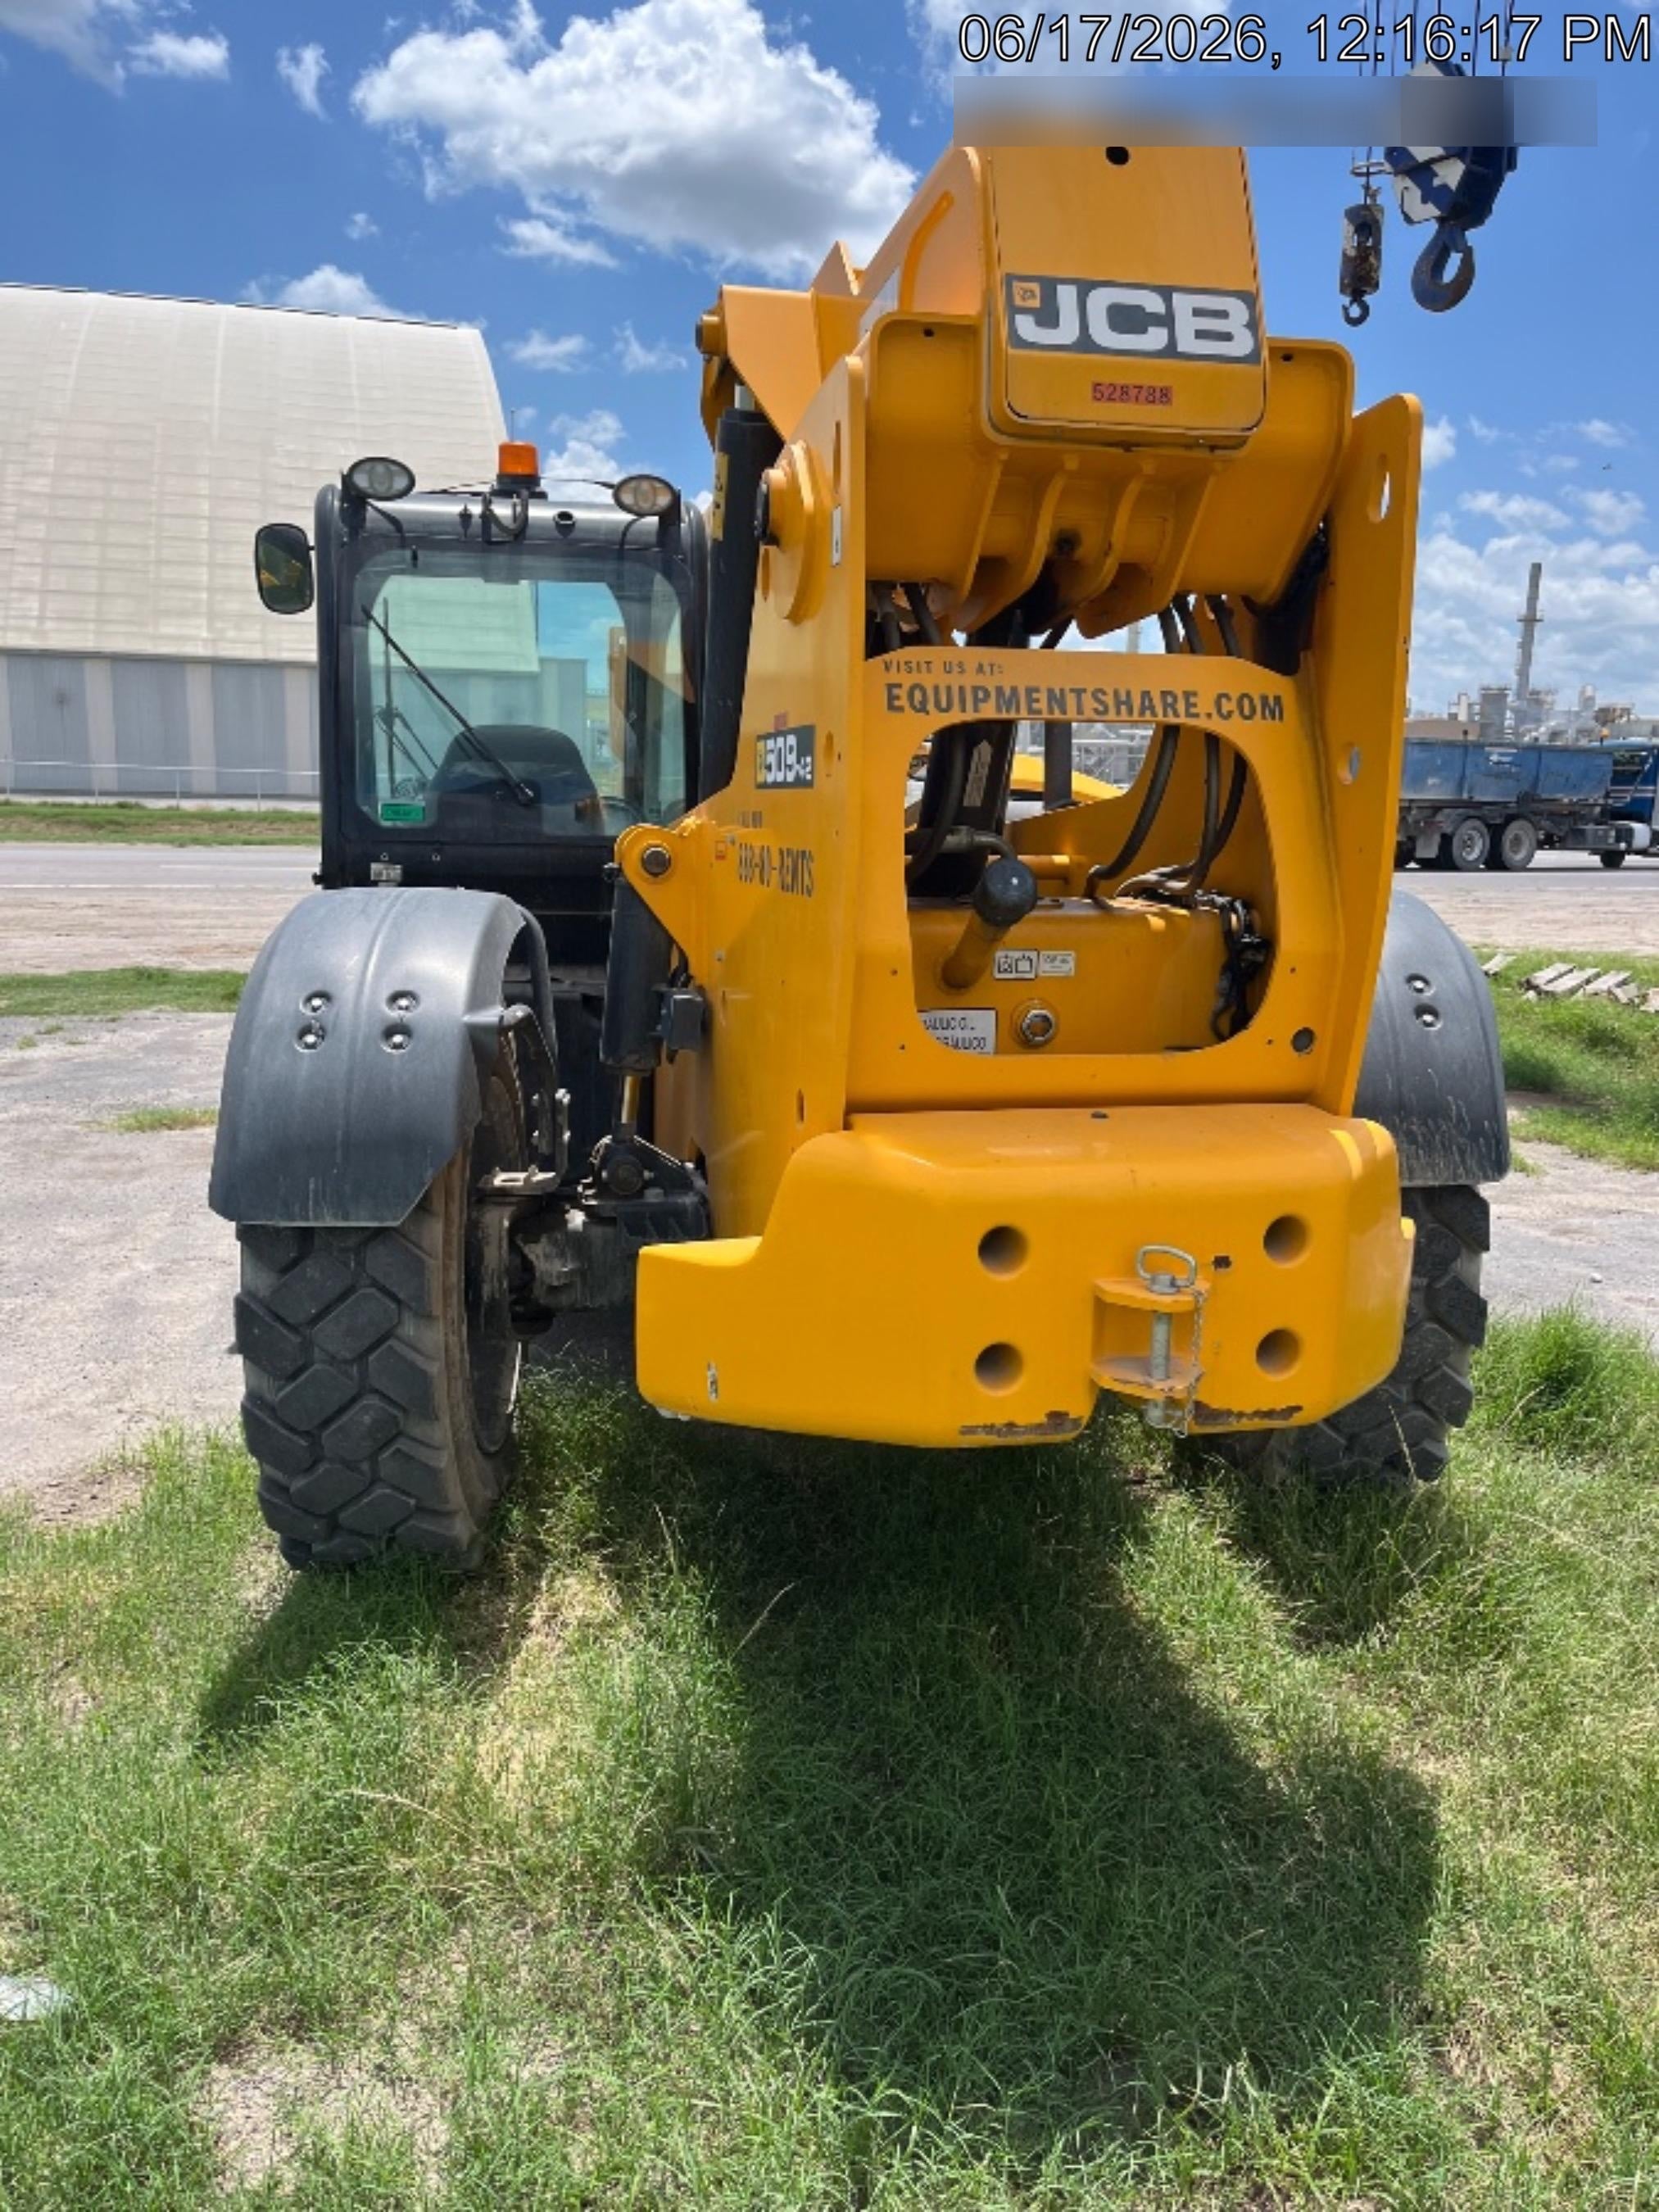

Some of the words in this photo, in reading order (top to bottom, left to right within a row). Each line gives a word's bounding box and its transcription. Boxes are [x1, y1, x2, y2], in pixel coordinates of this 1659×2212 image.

[1014, 283, 1254, 357] JCB
[883, 660, 933, 674] VISIT
[943, 660, 966, 674] US
[885, 682, 1285, 722] EQUIPMENTSHARE.COM
